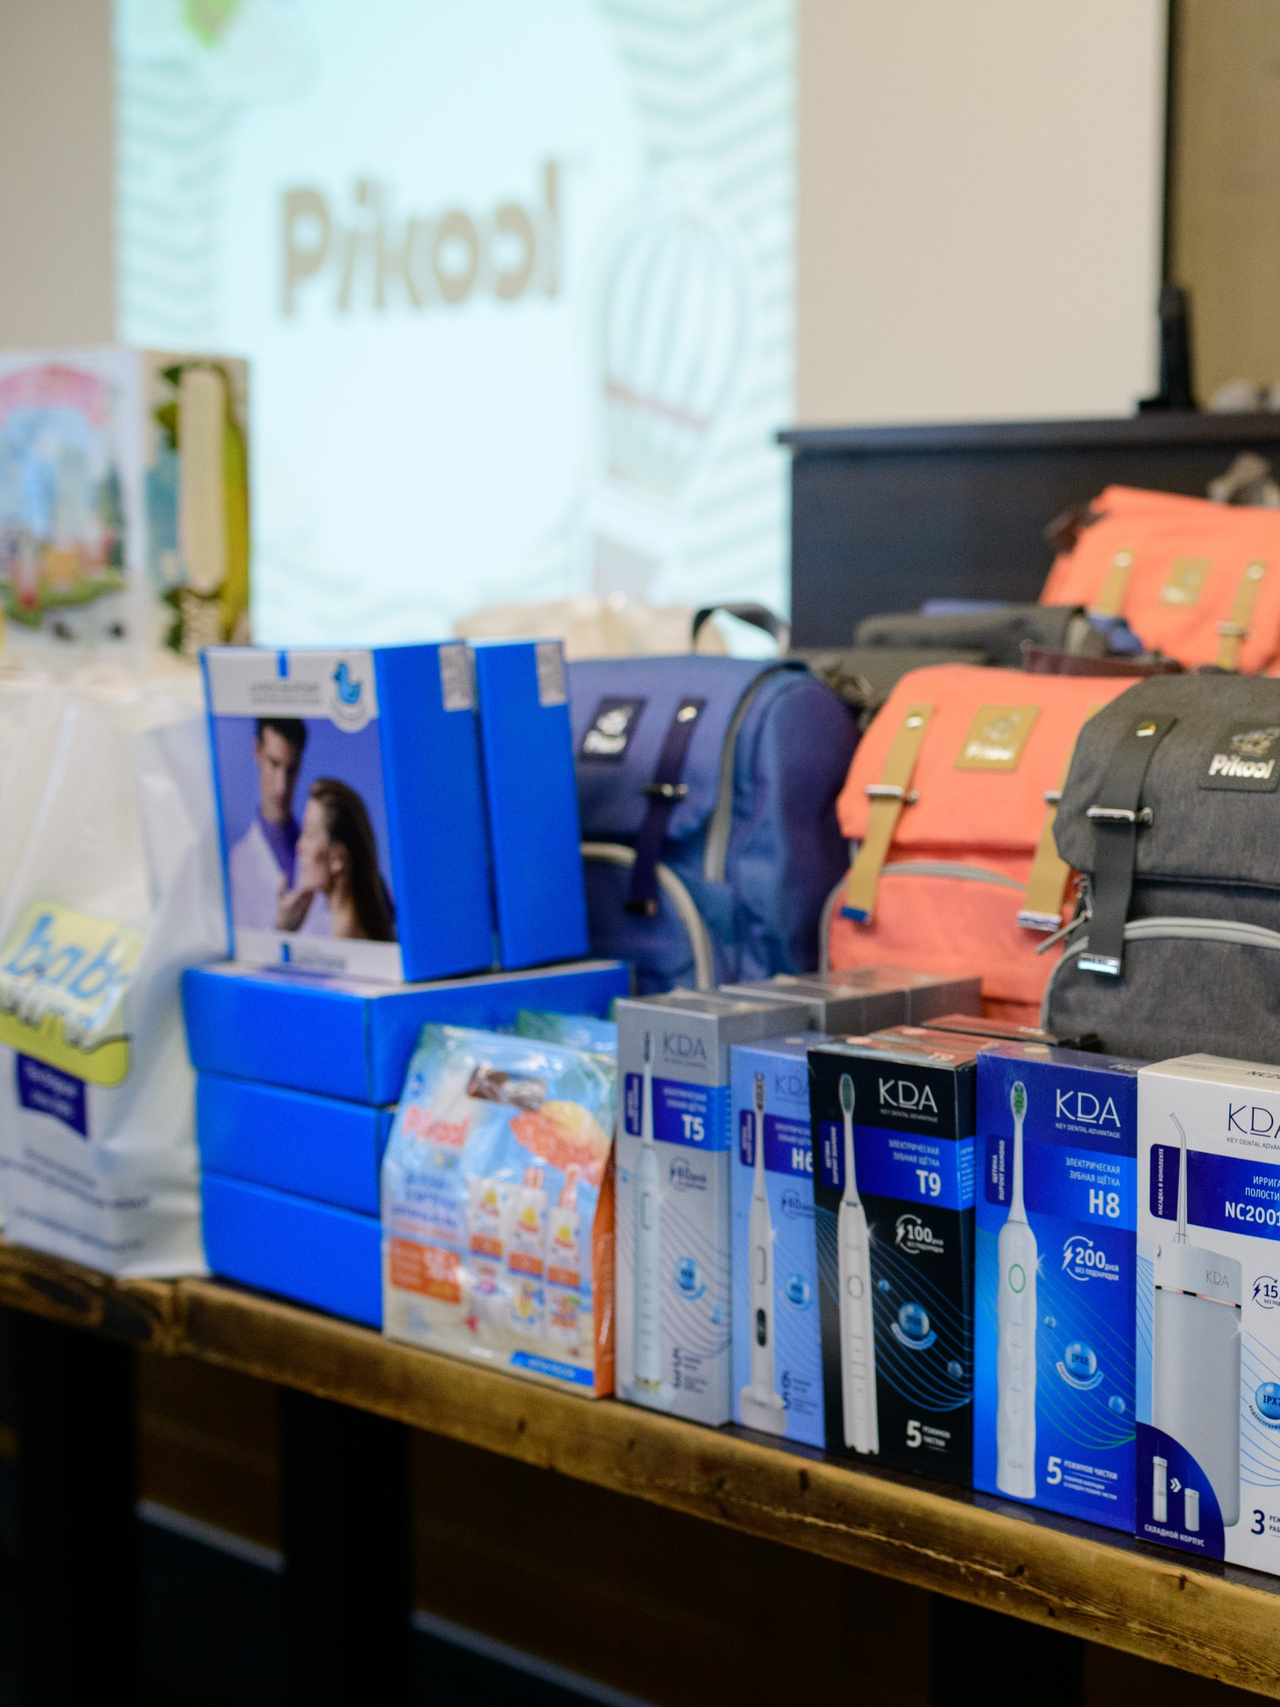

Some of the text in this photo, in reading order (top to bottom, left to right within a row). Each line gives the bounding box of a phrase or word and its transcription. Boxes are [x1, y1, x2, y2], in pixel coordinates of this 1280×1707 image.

[1208, 754, 1276, 779] Pikool
[663, 1032, 708, 1061] KDA
[878, 1077, 938, 1113] KDA
[1056, 1088, 1121, 1127] KDA
[681, 1114, 705, 1141] T5
[1239, 1138, 1261, 1148] DENTAL
[1066, 1157, 1120, 1174] ЭЛЕКТРИЧЕСКАЯ
[916, 1169, 941, 1197] T9
[1069, 1170, 1120, 1187] ЗУБНАЯ ЩЁТКА
[1089, 1188, 1120, 1218] H8
[1245, 1187, 1280, 1201] ПОЛОСТИ
[906, 1224, 932, 1243] 100
[1075, 1247, 1106, 1269] 200
[1205, 1270, 1229, 1288] KDA
[1263, 1284, 1278, 1298] 15
[906, 1419, 922, 1448] 5
[1046, 1456, 1062, 1485] 5
[1250, 1509, 1265, 1535] 3
[1144, 1523, 1205, 1547] СКЛАДНОЙ КОРПУС
